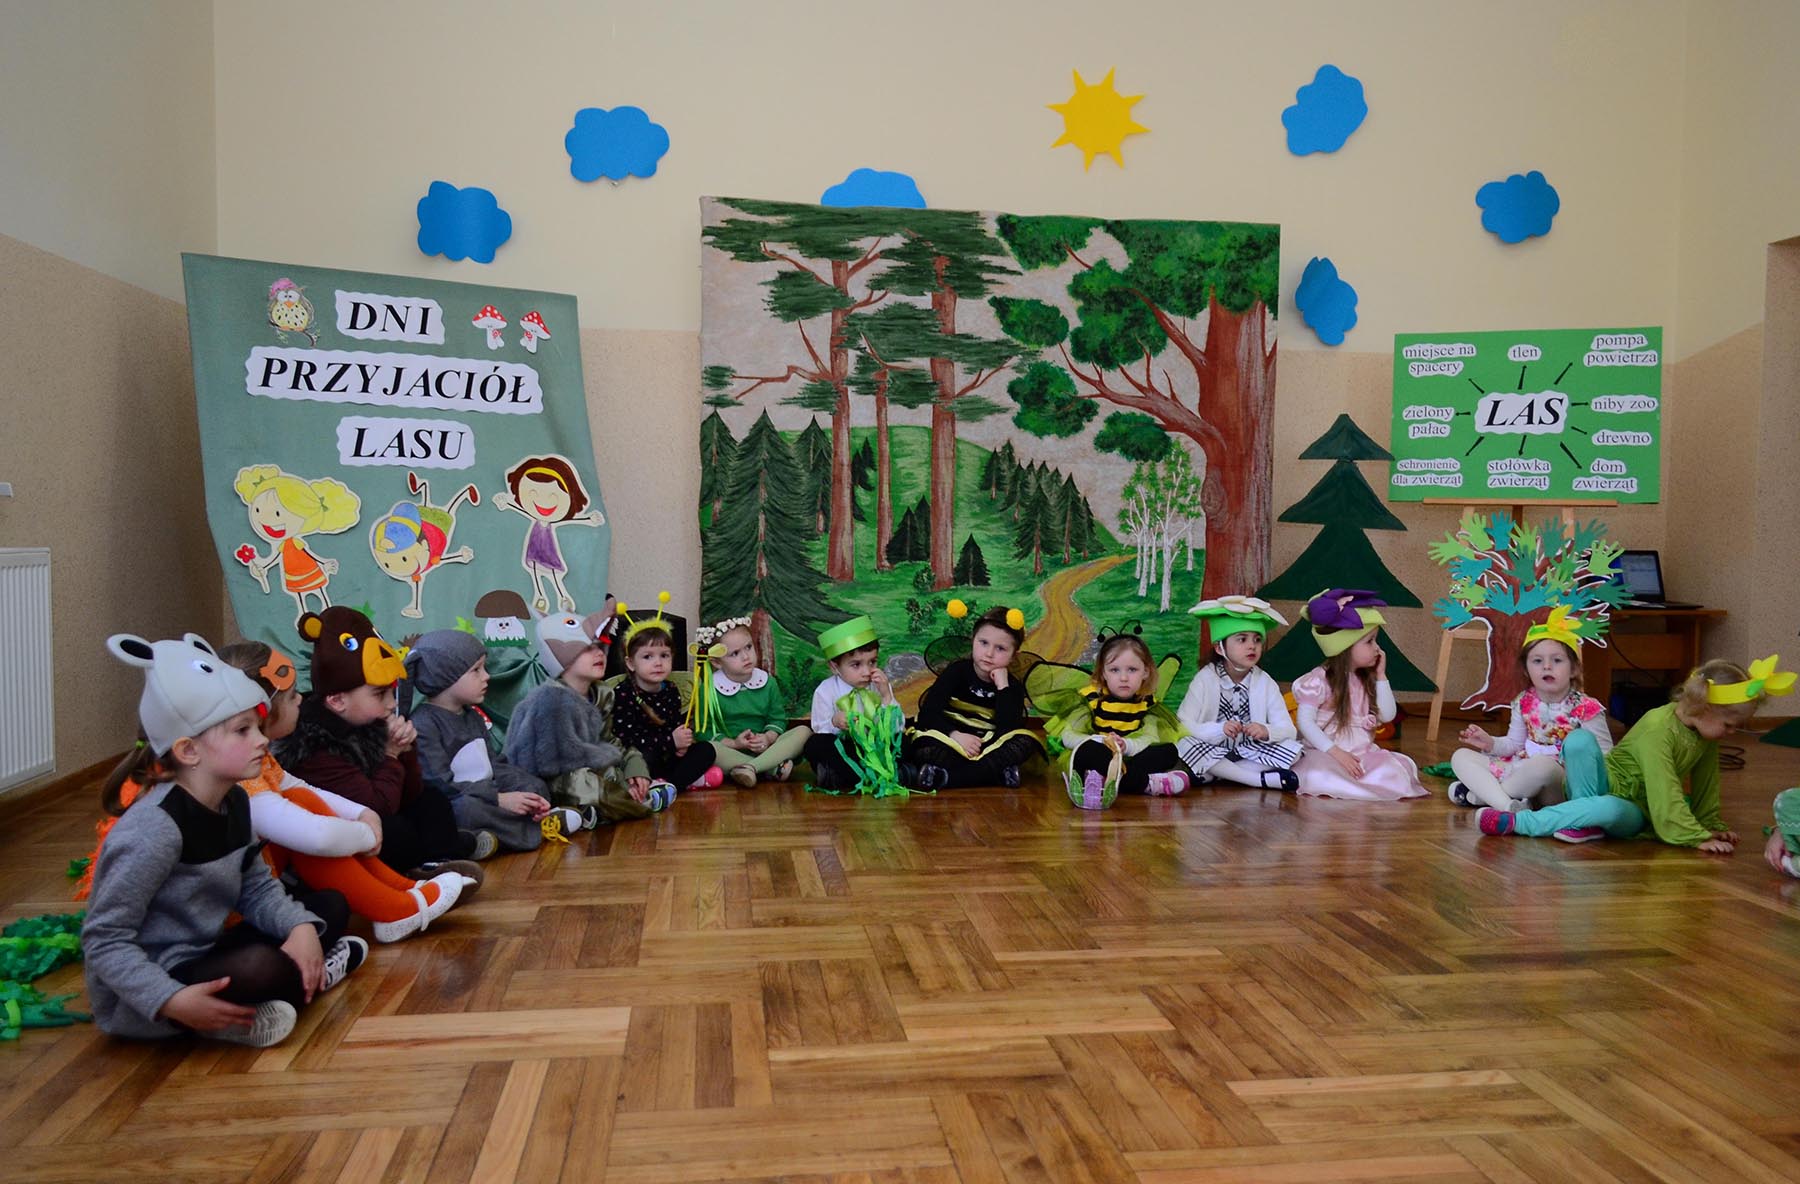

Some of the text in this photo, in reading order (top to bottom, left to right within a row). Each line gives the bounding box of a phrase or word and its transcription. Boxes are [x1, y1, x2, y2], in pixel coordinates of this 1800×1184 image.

[347, 301, 433, 336] DNI
[1596, 334, 1645, 347] pompa
[1404, 345, 1474, 360] miejsce na
[1512, 347, 1538, 359] tlen
[1586, 352, 1657, 366] powietrza
[1410, 362, 1461, 375] spacery
[258, 356, 533, 405] PRZYJACIÓŁ
[1593, 398, 1656, 411] niby zoo
[1404, 407, 1451, 420] zielony
[1484, 397, 1564, 427] LAS
[1411, 423, 1447, 436] pałac
[351, 426, 467, 461] LASU
[1596, 432, 1650, 445] drewno
[1399, 460, 1458, 470] schronienie
[1488, 460, 1550, 472] stołówka
[1591, 460, 1623, 473] dom
[1392, 475, 1462, 486] dla zwierząt
[1489, 475, 1547, 489] zwierząt
[1574, 478, 1635, 491] zwierząt
